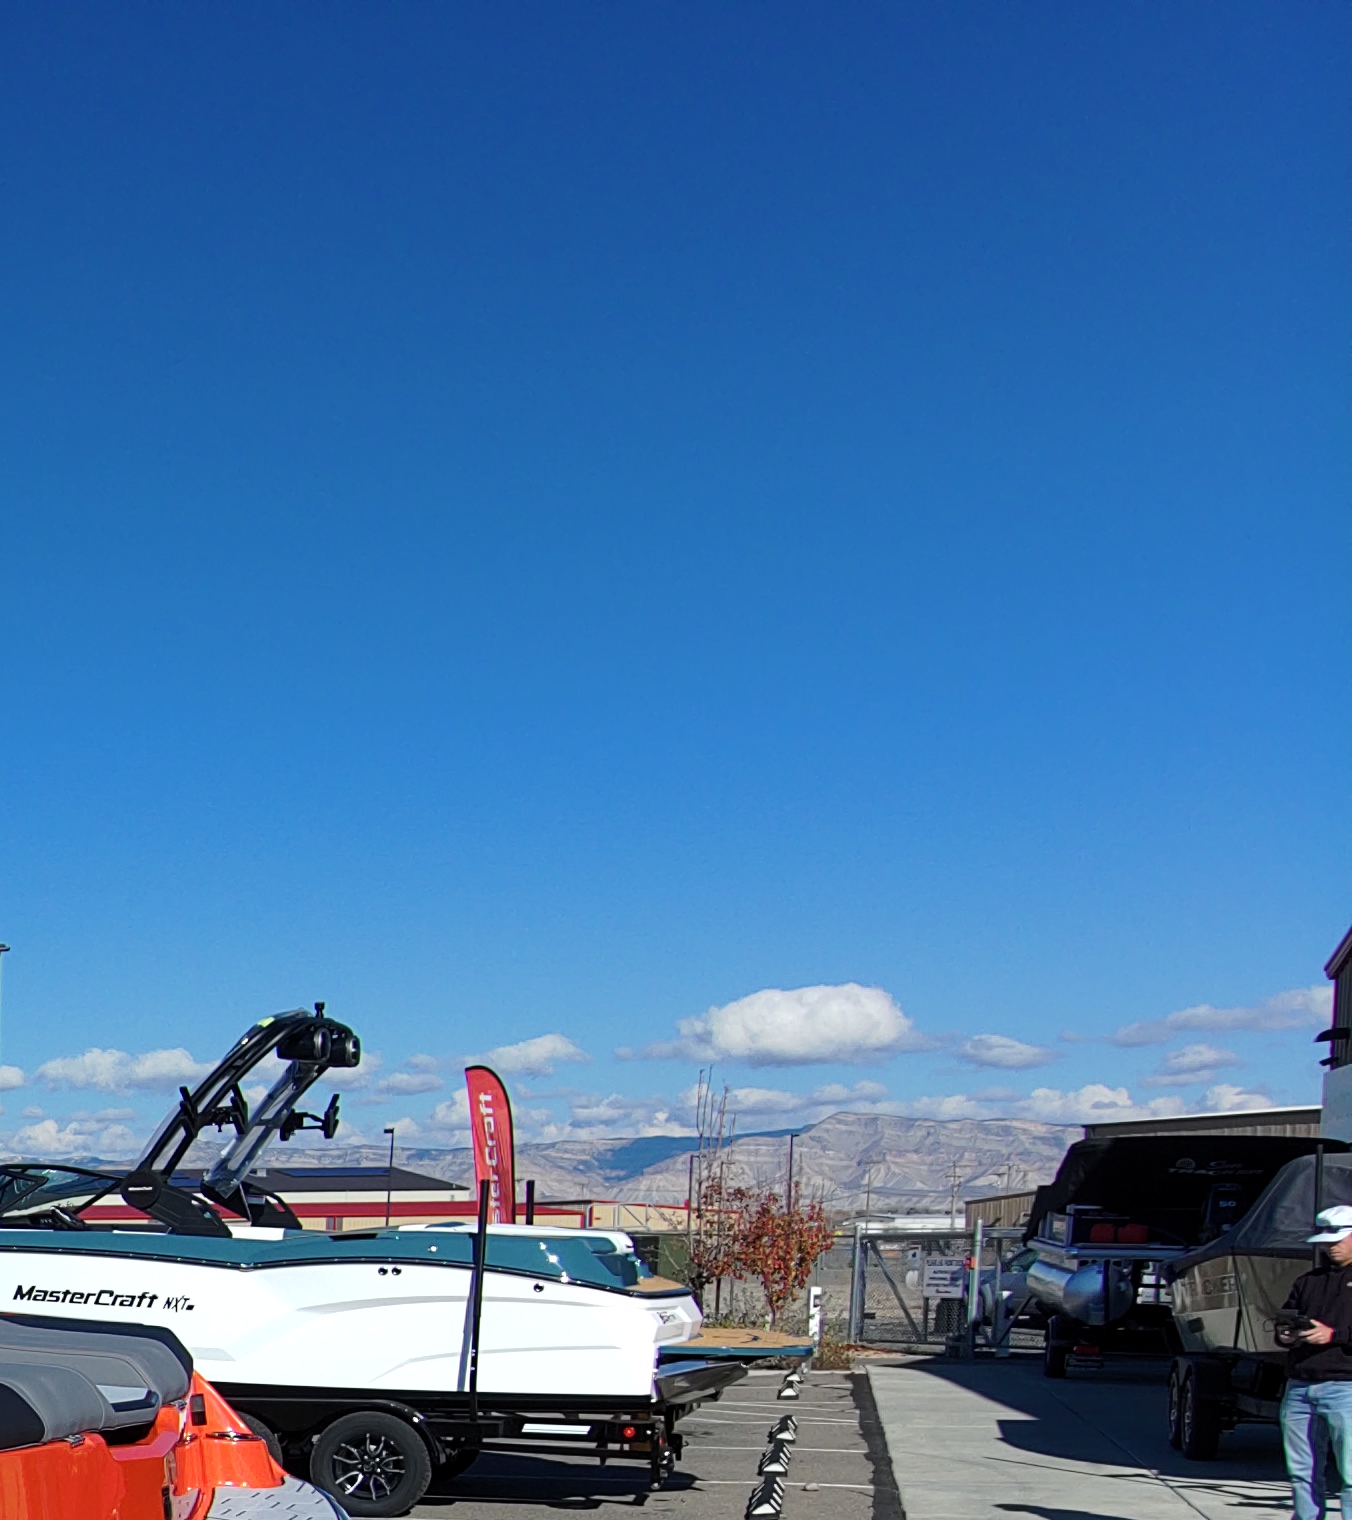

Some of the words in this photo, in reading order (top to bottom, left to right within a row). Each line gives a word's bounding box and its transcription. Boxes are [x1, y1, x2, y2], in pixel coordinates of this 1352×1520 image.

[478, 1091, 501, 1224] sterCraft
[12, 1284, 159, 1309] MasterCraft
[163, 1295, 190, 1313] NXT
